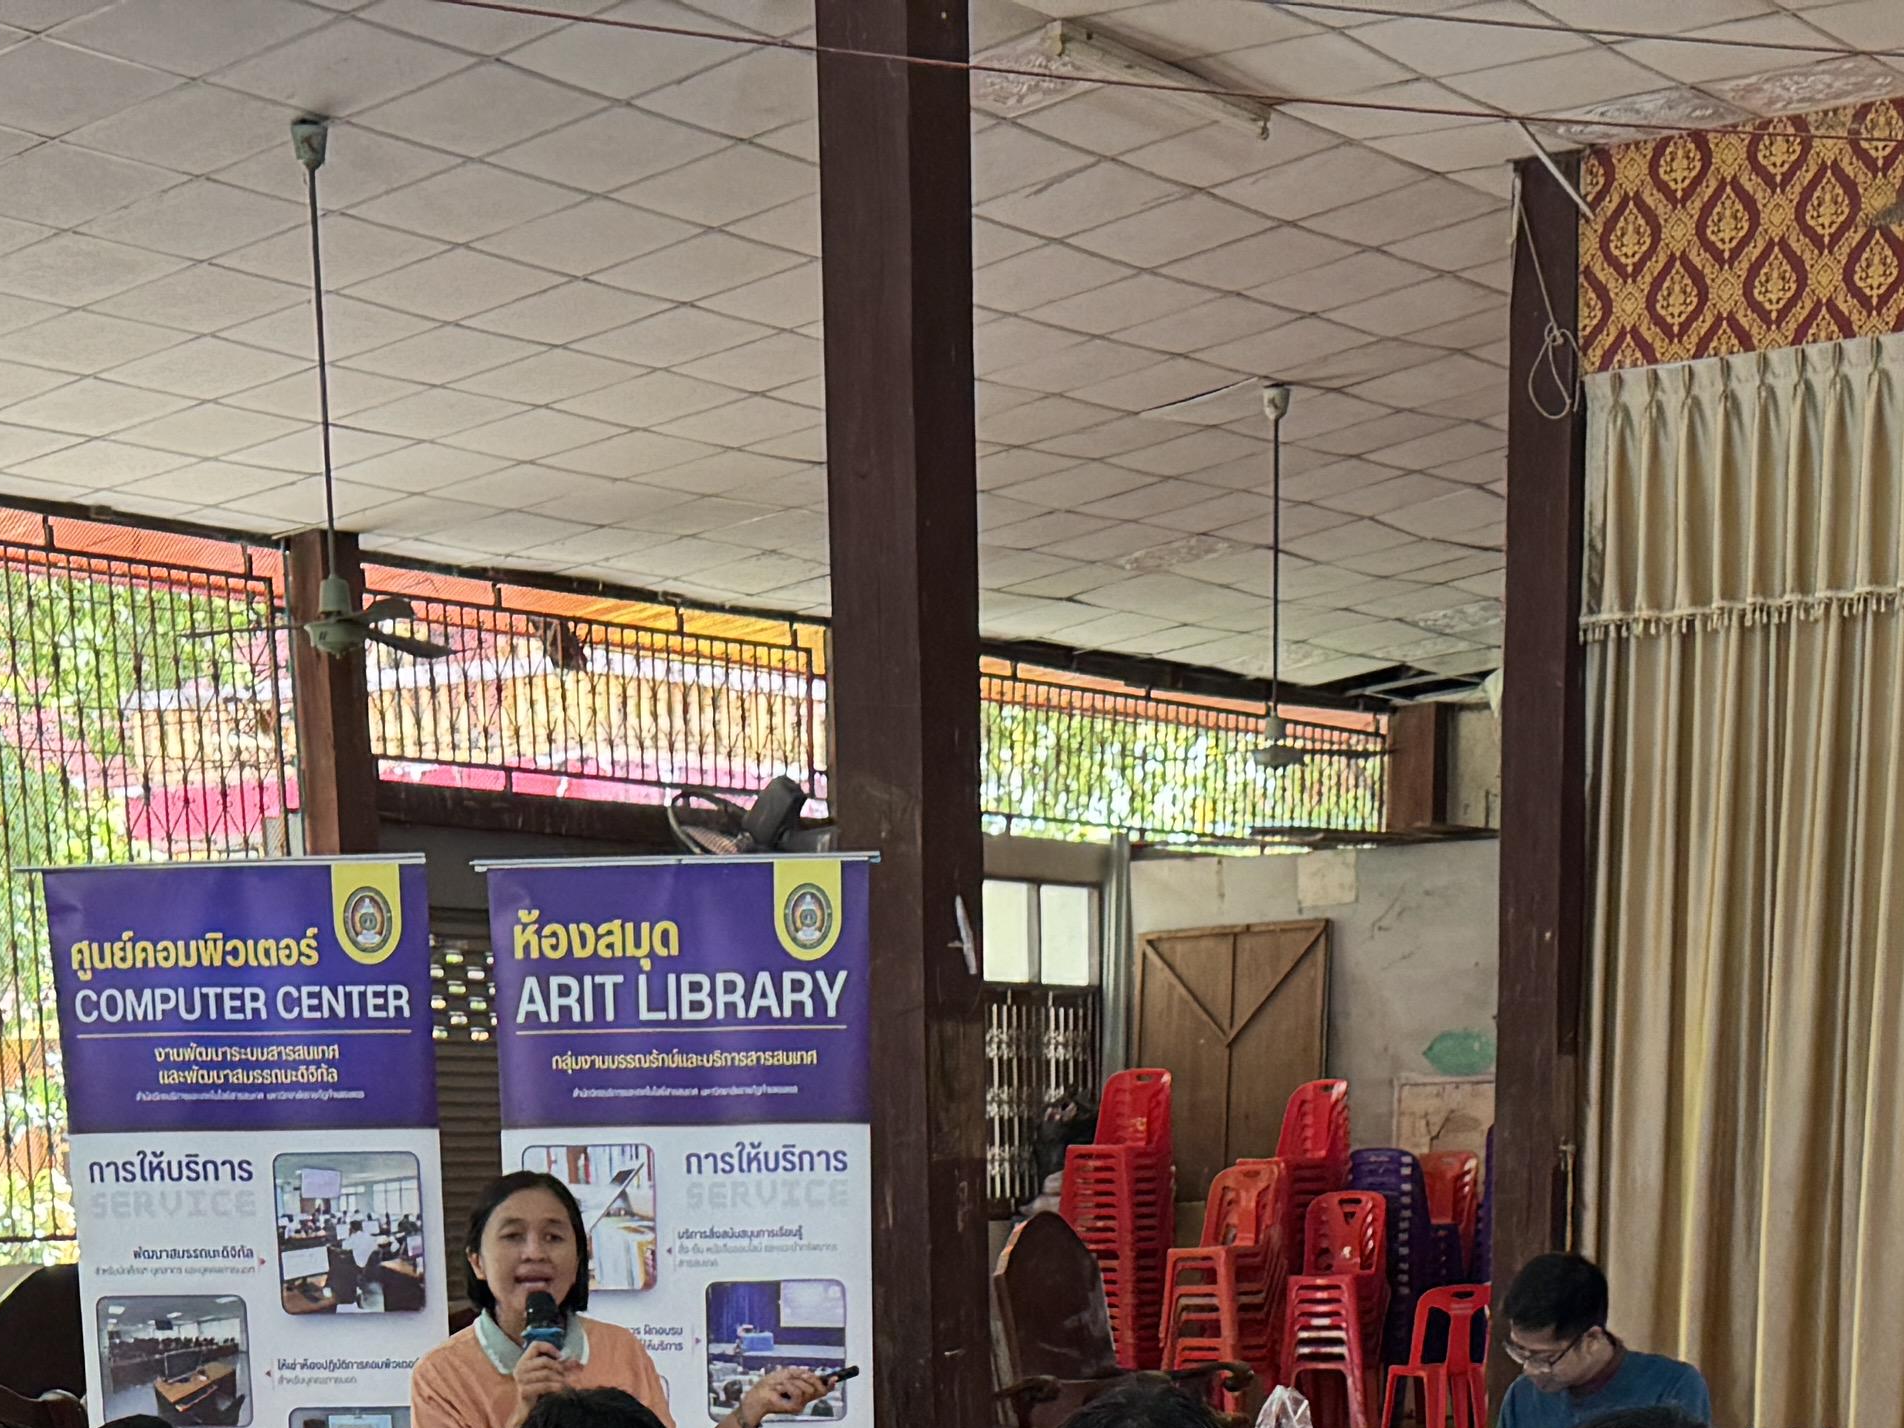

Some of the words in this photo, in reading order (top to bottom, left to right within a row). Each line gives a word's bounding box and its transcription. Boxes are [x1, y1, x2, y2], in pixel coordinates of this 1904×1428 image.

[70, 927, 320, 981] ศูนย์คอมพิวเตอร์
[513, 909, 680, 971] ห้องสมุด
[75, 985, 267, 1024] COMPUTER
[277, 984, 411, 1020] CENTER
[515, 974, 624, 1024] ARIT
[638, 969, 848, 1022] LIBRARY
[88, 1151, 254, 1184] การให้บริการ
[686, 1142, 848, 1175] การให้บริการ
